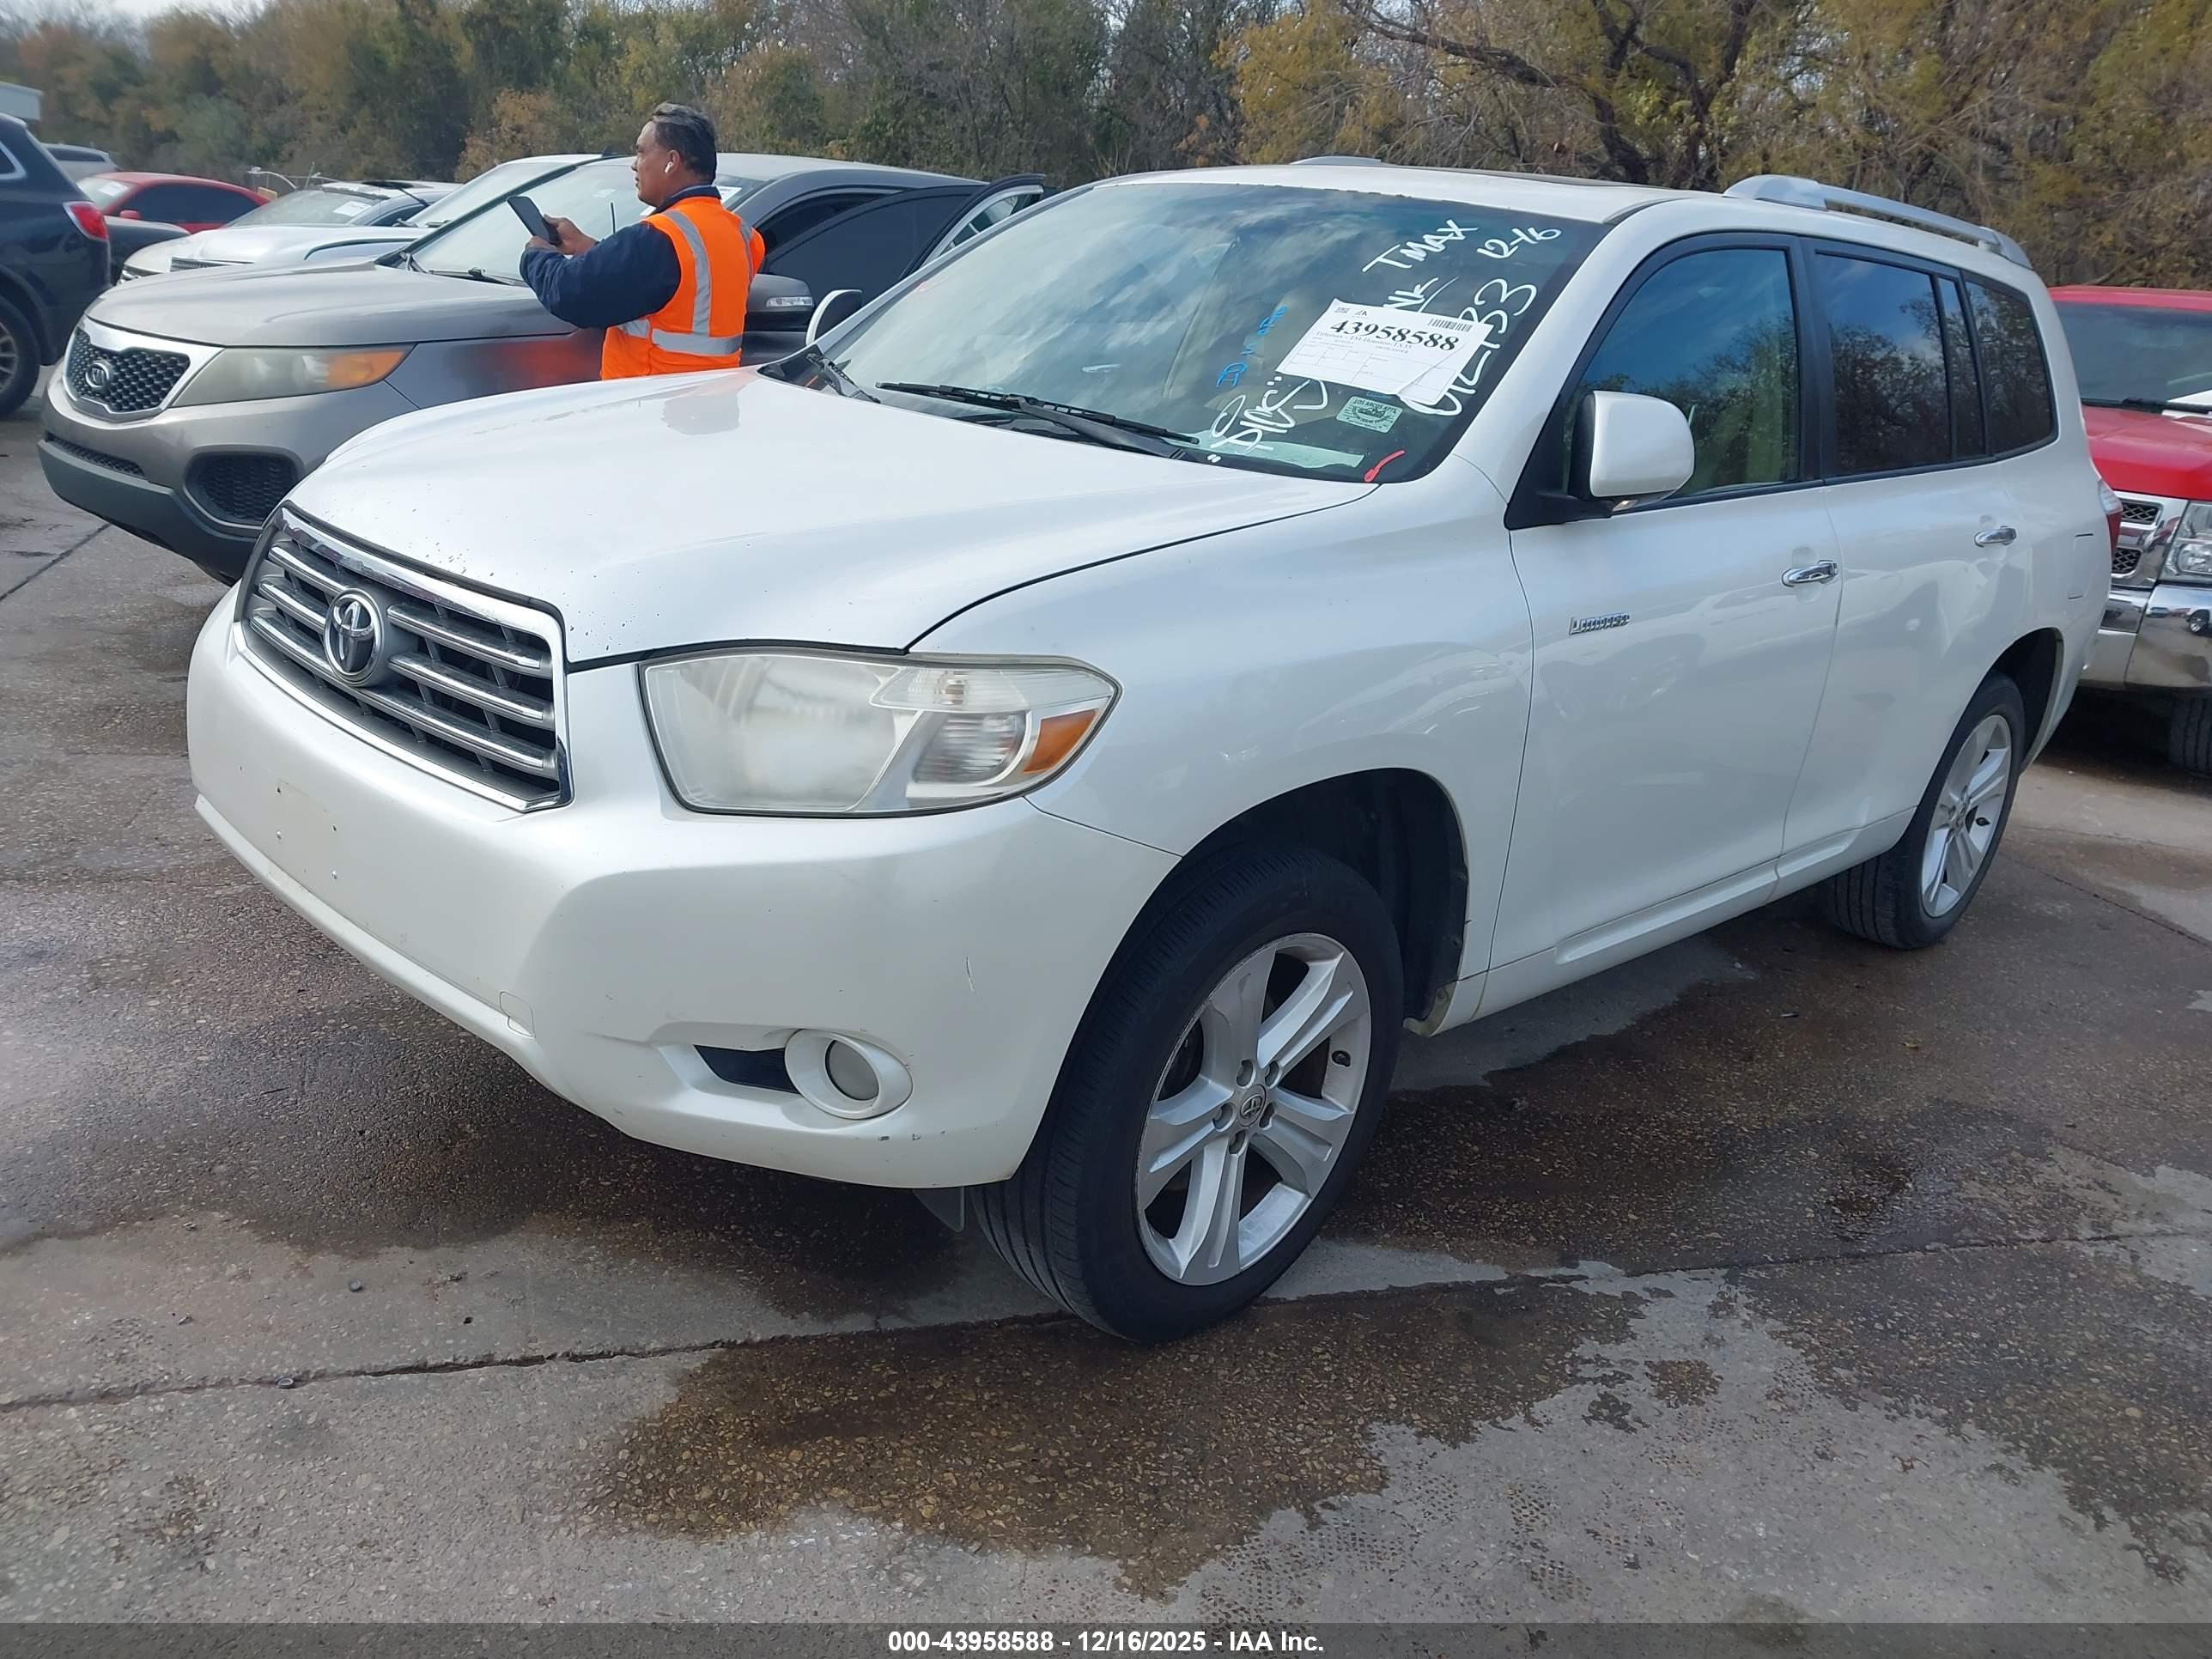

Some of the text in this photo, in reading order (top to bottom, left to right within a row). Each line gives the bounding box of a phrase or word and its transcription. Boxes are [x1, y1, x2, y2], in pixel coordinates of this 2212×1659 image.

[1362, 219, 1479, 273] TMAX
[1476, 227, 1562, 259] 12-16
[1330, 319, 1460, 351] 43958588
